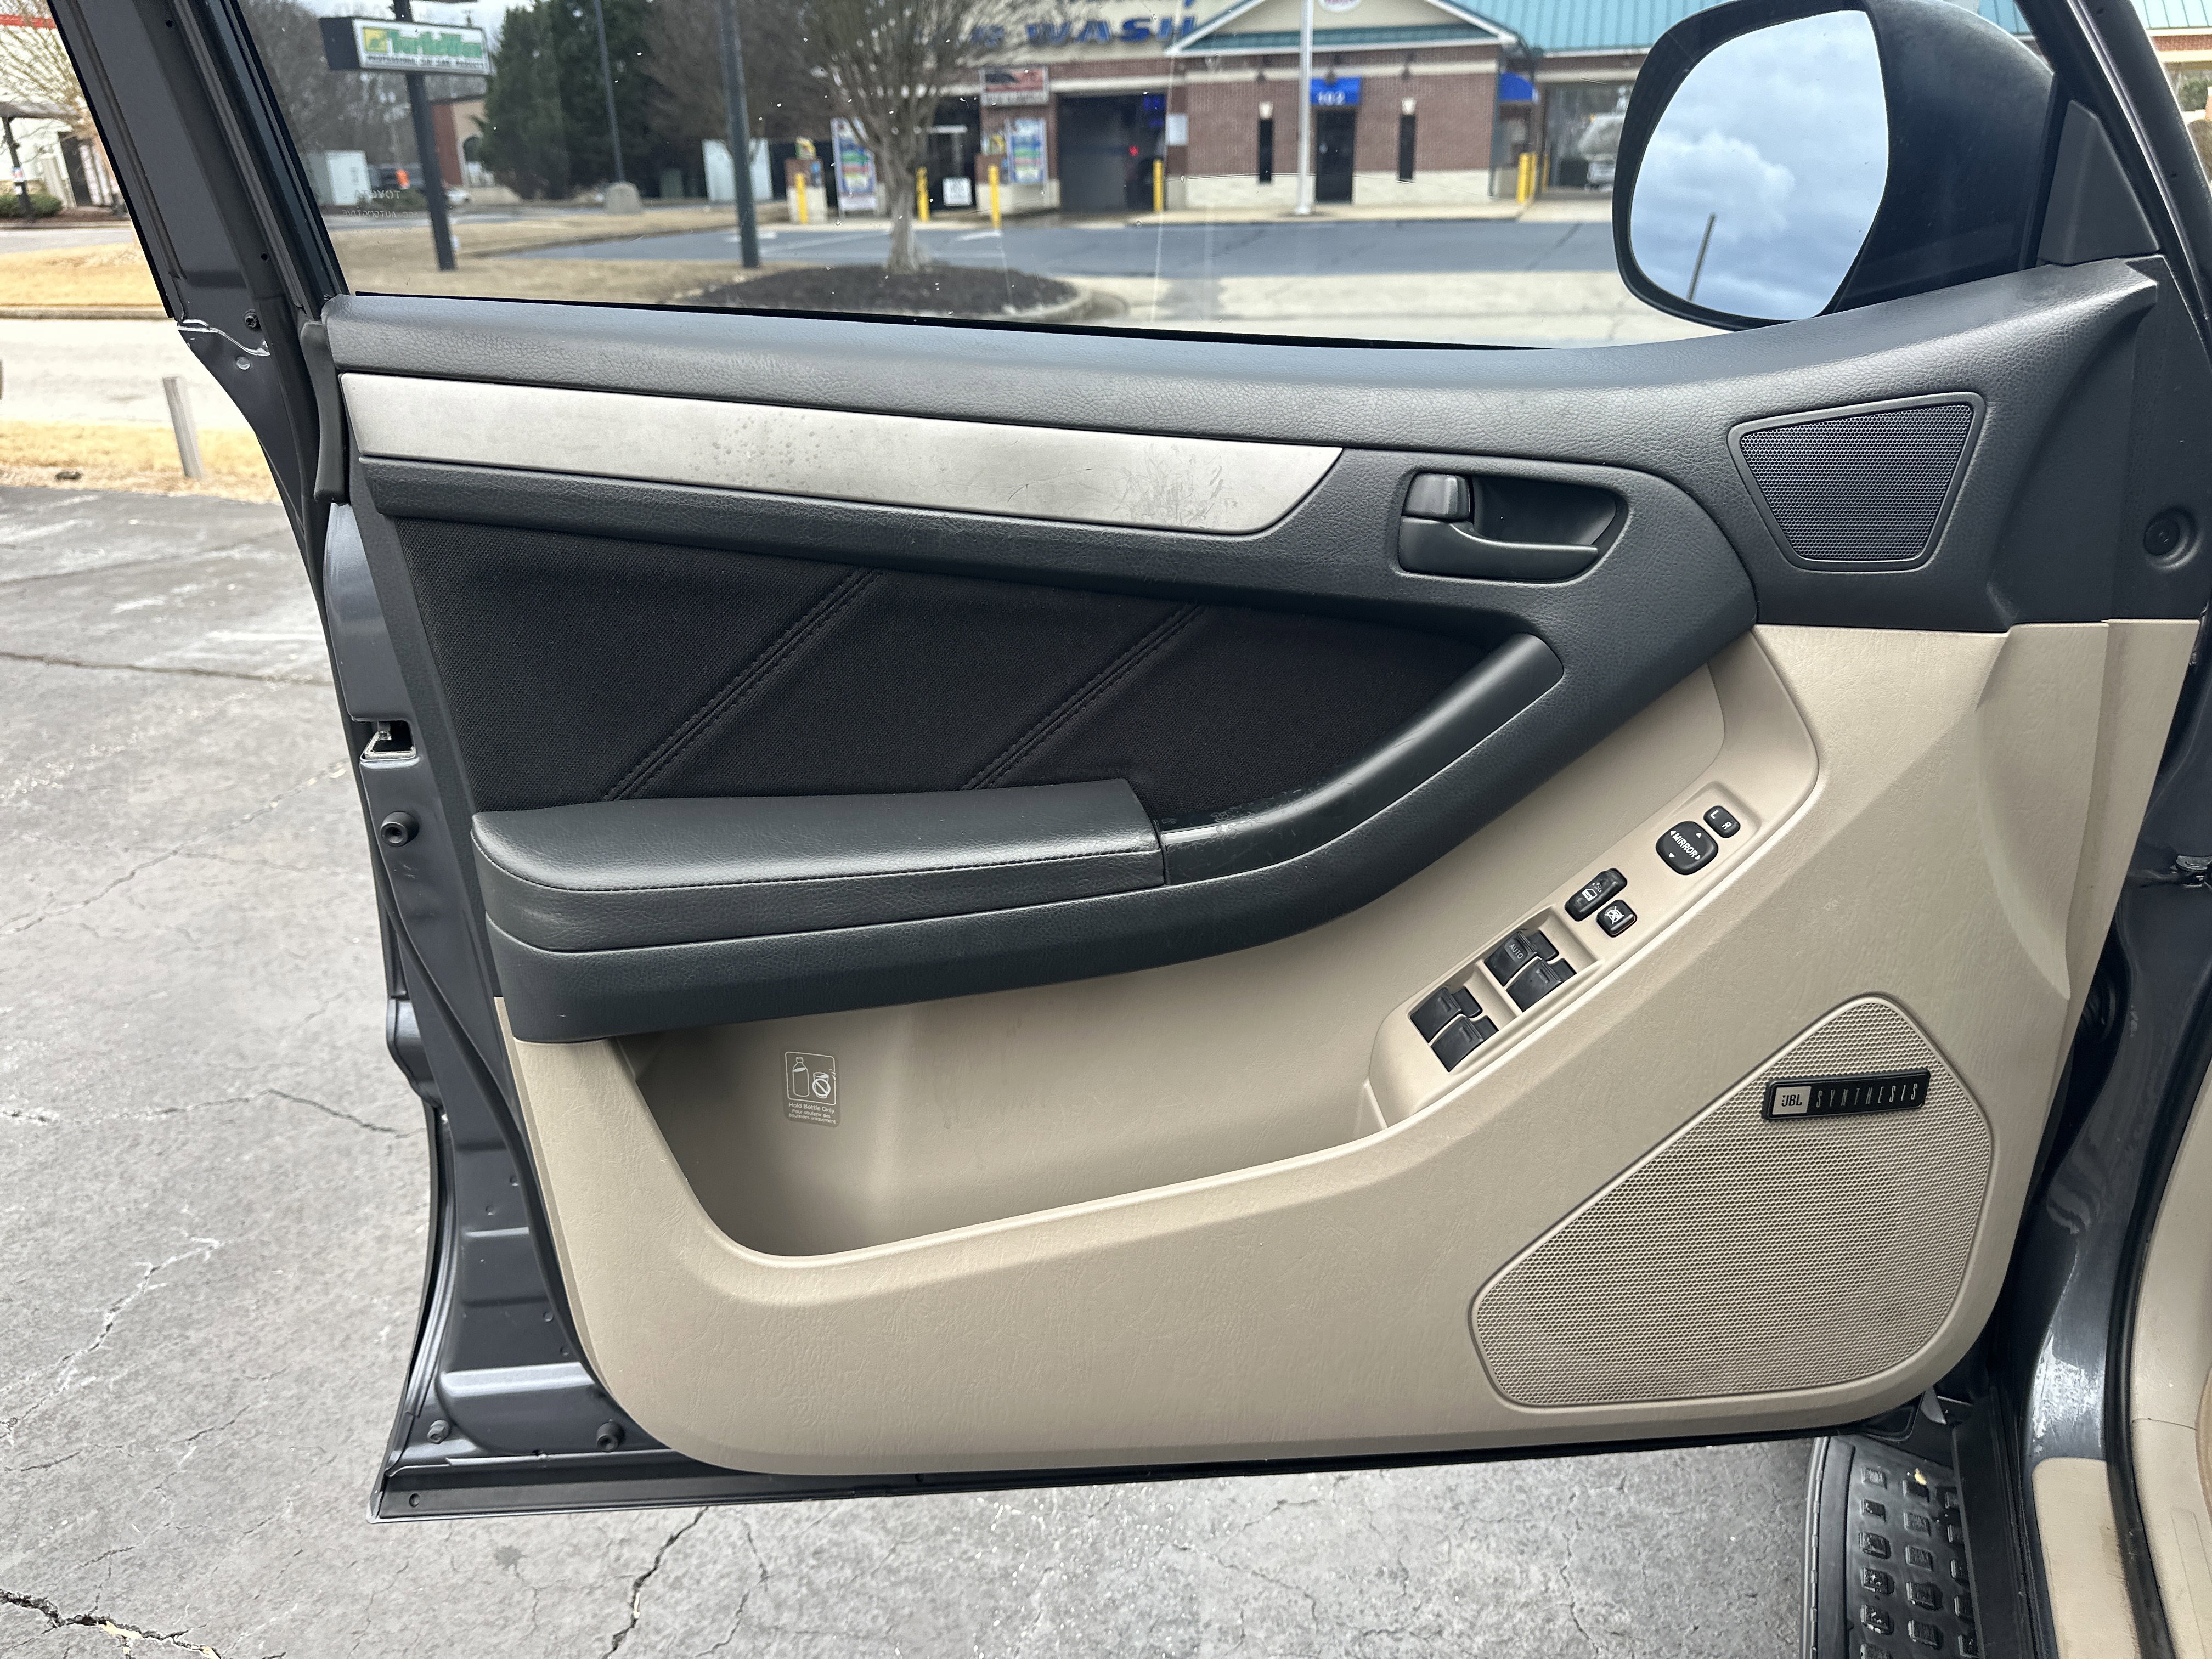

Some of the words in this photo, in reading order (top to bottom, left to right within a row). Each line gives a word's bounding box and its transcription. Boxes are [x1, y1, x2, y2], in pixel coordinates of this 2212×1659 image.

[1027, 17, 1196, 46] WASH
[1710, 810, 1719, 819] L
[1722, 821, 1731, 830] R
[1672, 832, 1699, 858] MIRROR
[1509, 944, 1523, 959] AUTO
[1781, 1093, 1802, 1107] JBL
[1816, 1082, 1918, 1108] SYNTHESIS
[822, 1106, 835, 1114] Only
